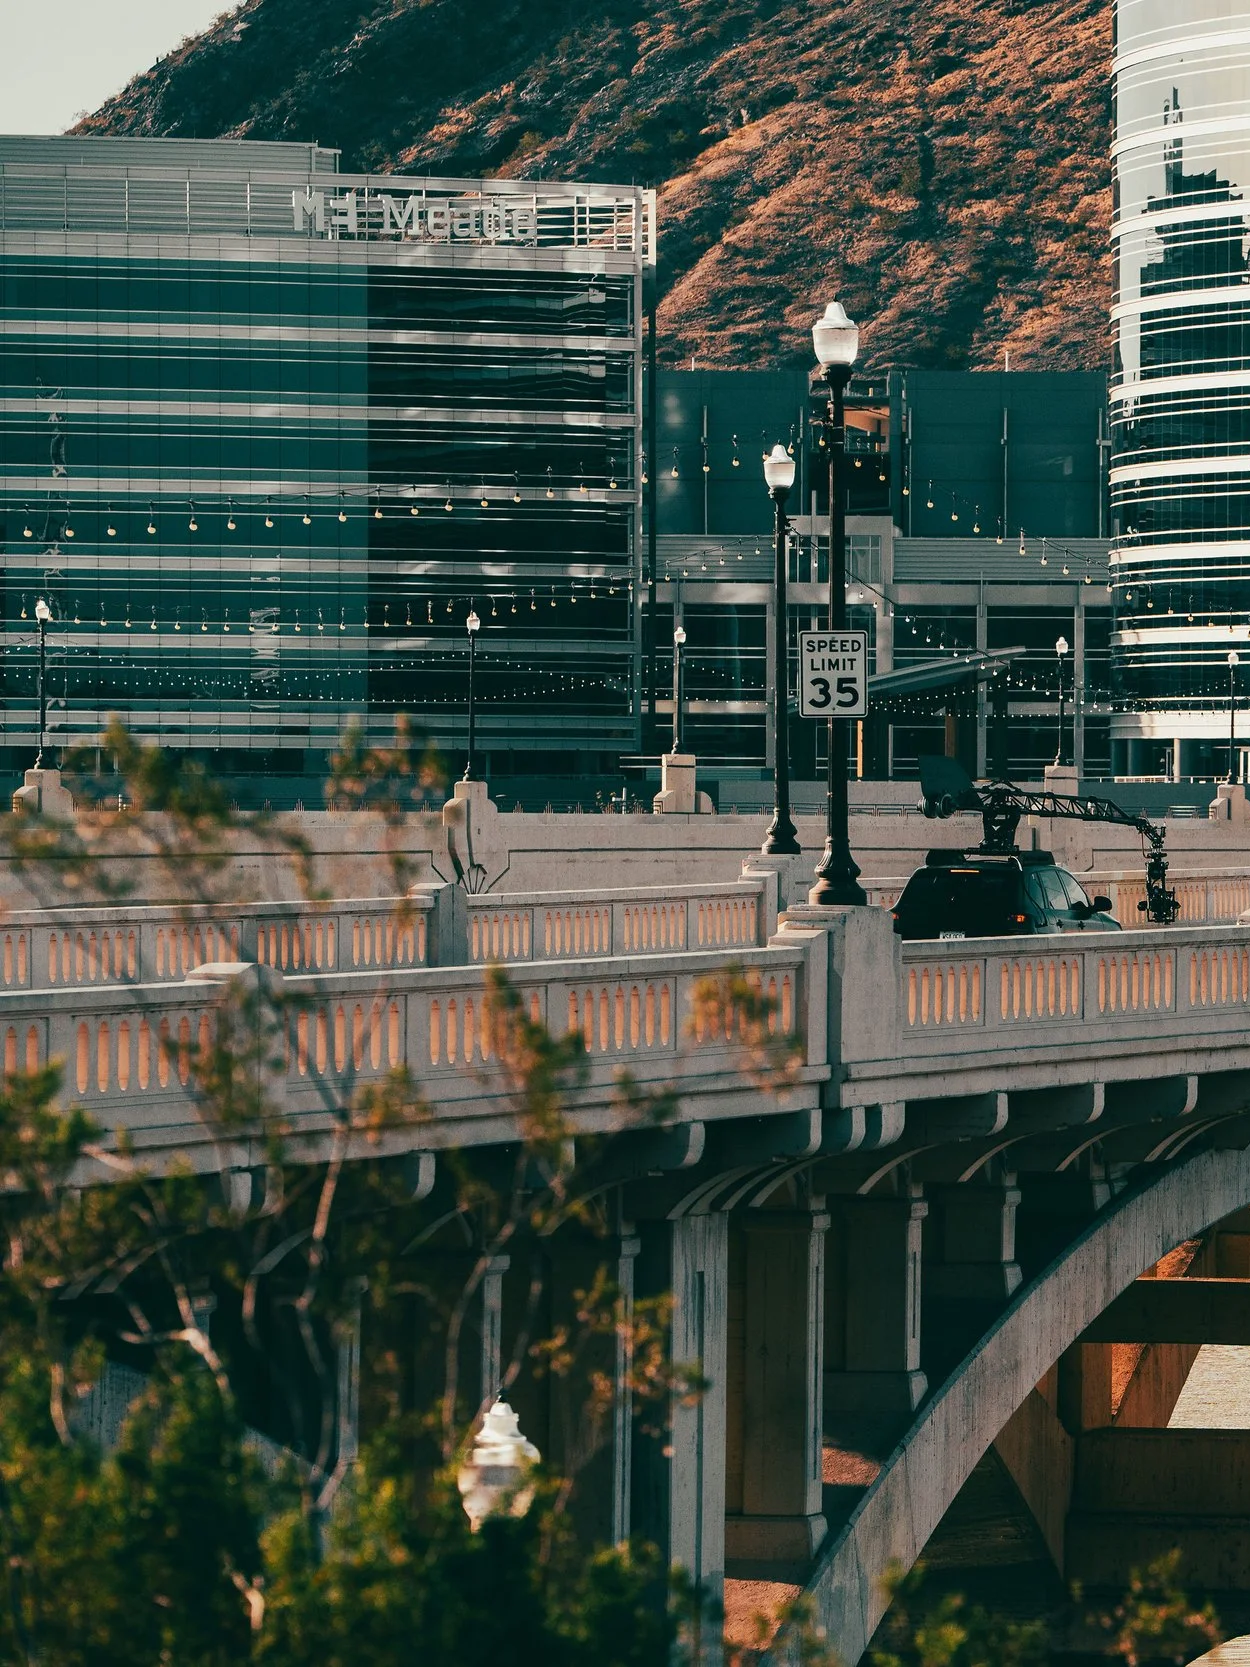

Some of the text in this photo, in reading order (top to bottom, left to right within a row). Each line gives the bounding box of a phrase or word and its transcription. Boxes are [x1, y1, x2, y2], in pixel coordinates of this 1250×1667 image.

[378, 194, 536, 240] Meade
[806, 639, 862, 653] SPEED
[810, 658, 857, 672] LIMIT
[808, 677, 860, 709] 35
